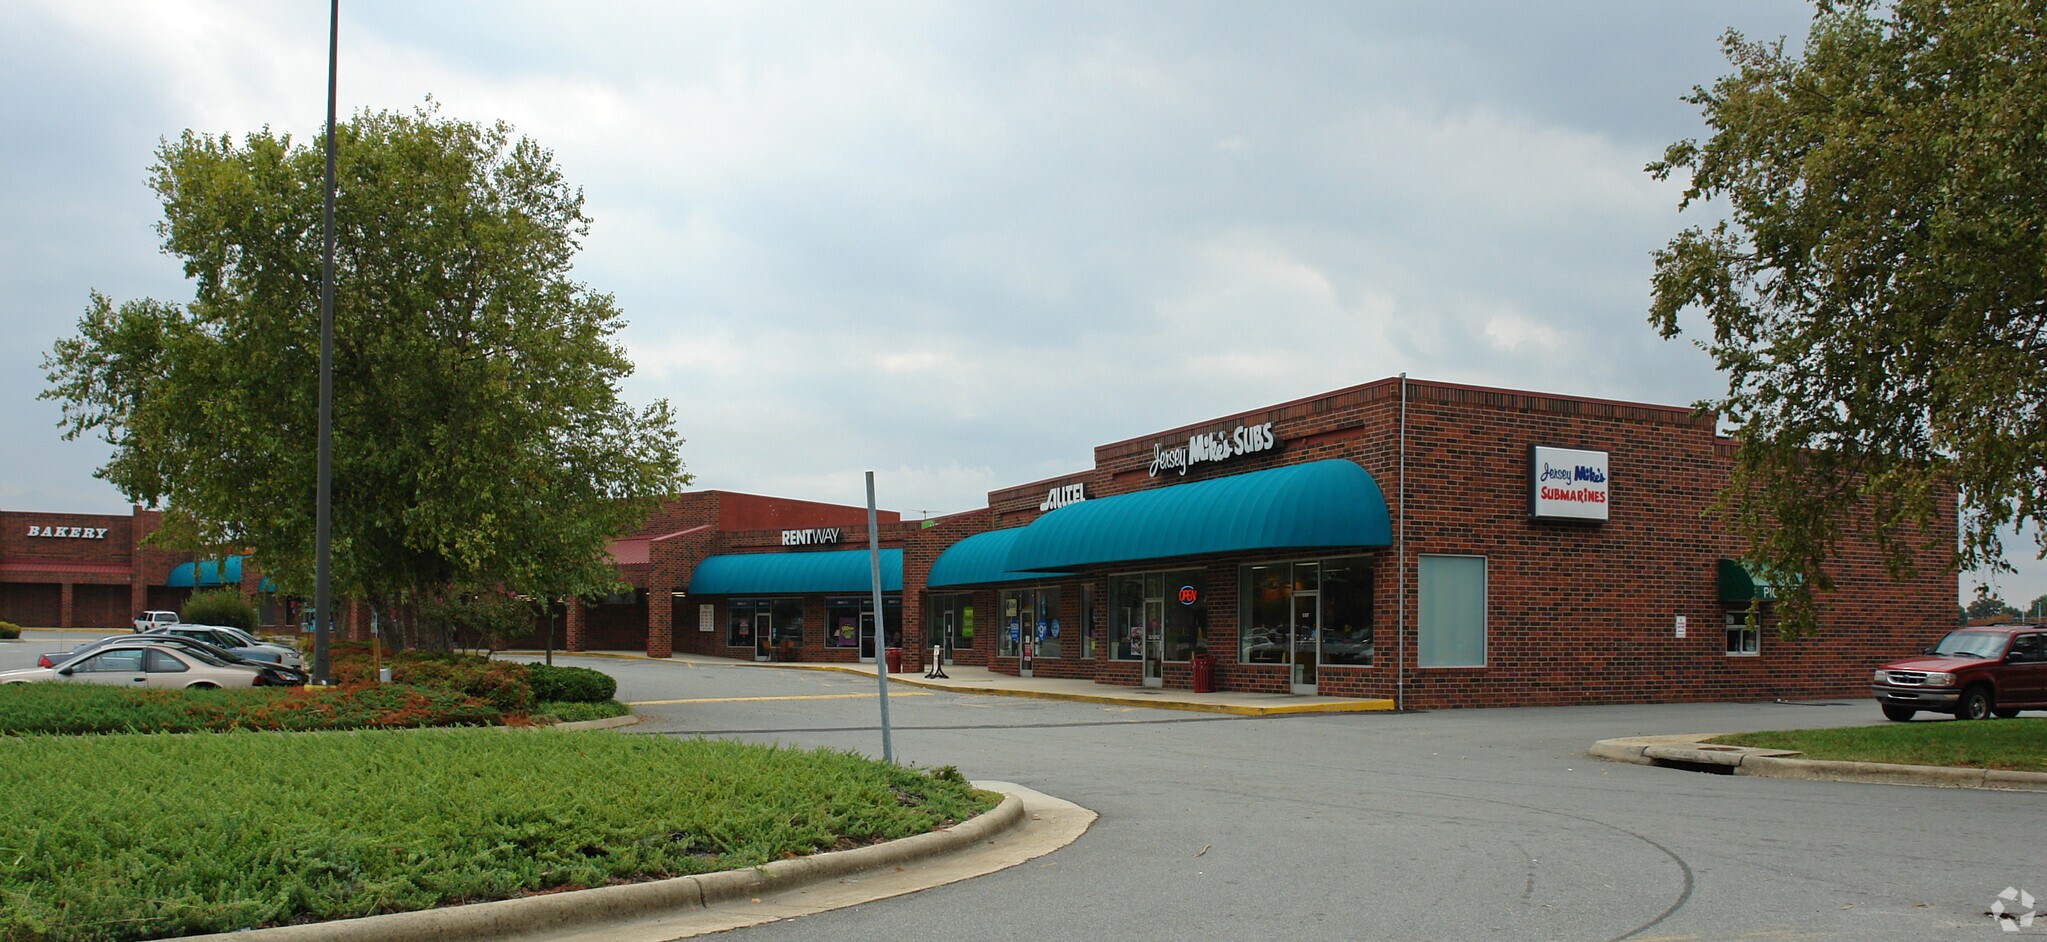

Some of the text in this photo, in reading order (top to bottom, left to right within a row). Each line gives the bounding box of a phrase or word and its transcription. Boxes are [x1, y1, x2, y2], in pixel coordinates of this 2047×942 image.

[1149, 422, 1274, 478] Jersey Mike's SUBS
[1540, 462, 1606, 486] Jersey Mike's
[1040, 482, 1086, 511] ALLTEL
[27, 525, 108, 539] BAKERY
[1178, 589, 1197, 602] OPEN
